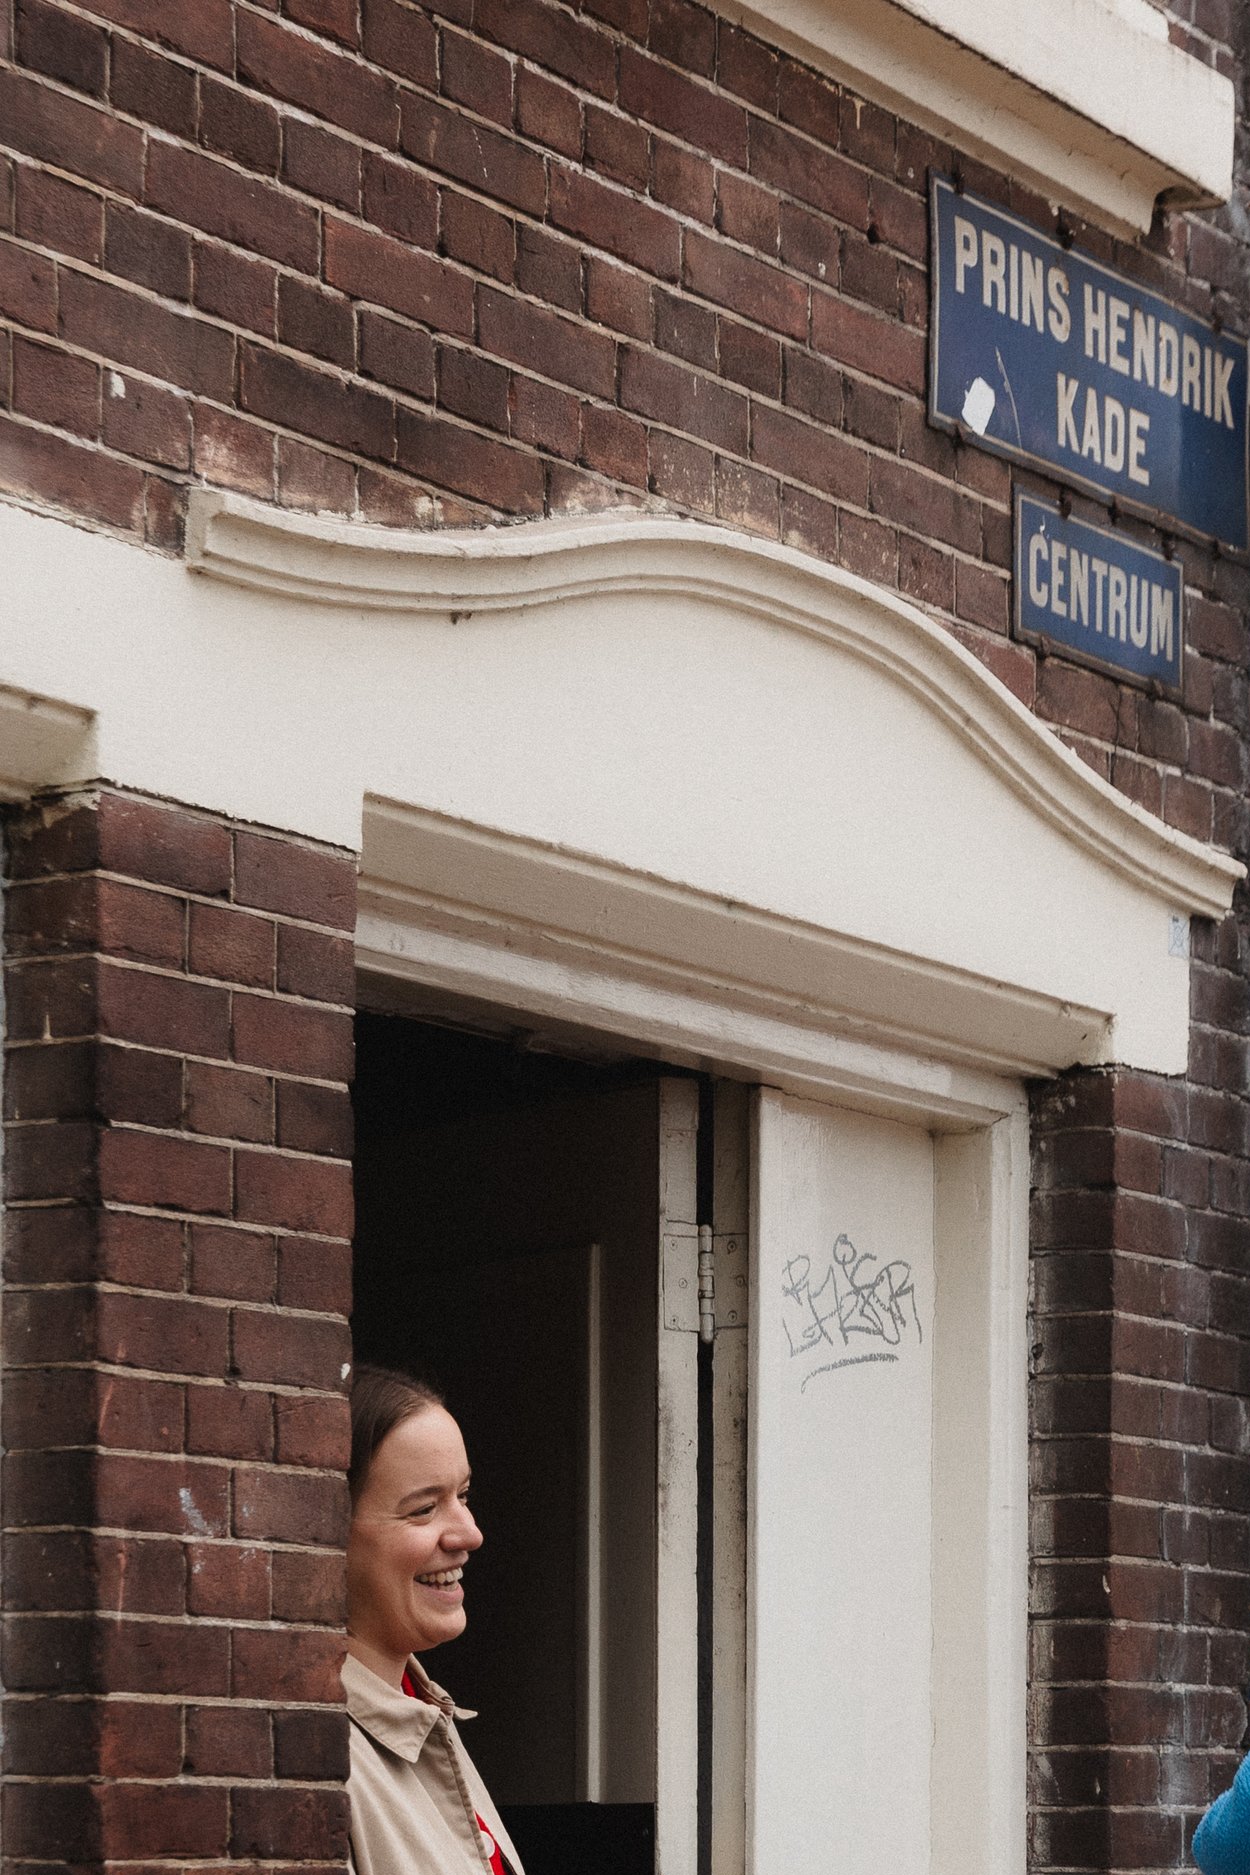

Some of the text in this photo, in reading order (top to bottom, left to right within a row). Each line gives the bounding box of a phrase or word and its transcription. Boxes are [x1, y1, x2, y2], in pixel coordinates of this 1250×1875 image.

[954, 215, 1235, 429] PRINS HENDRIK
[1056, 373, 1150, 486] KADE
[1028, 533, 1174, 662] CENTRUM
